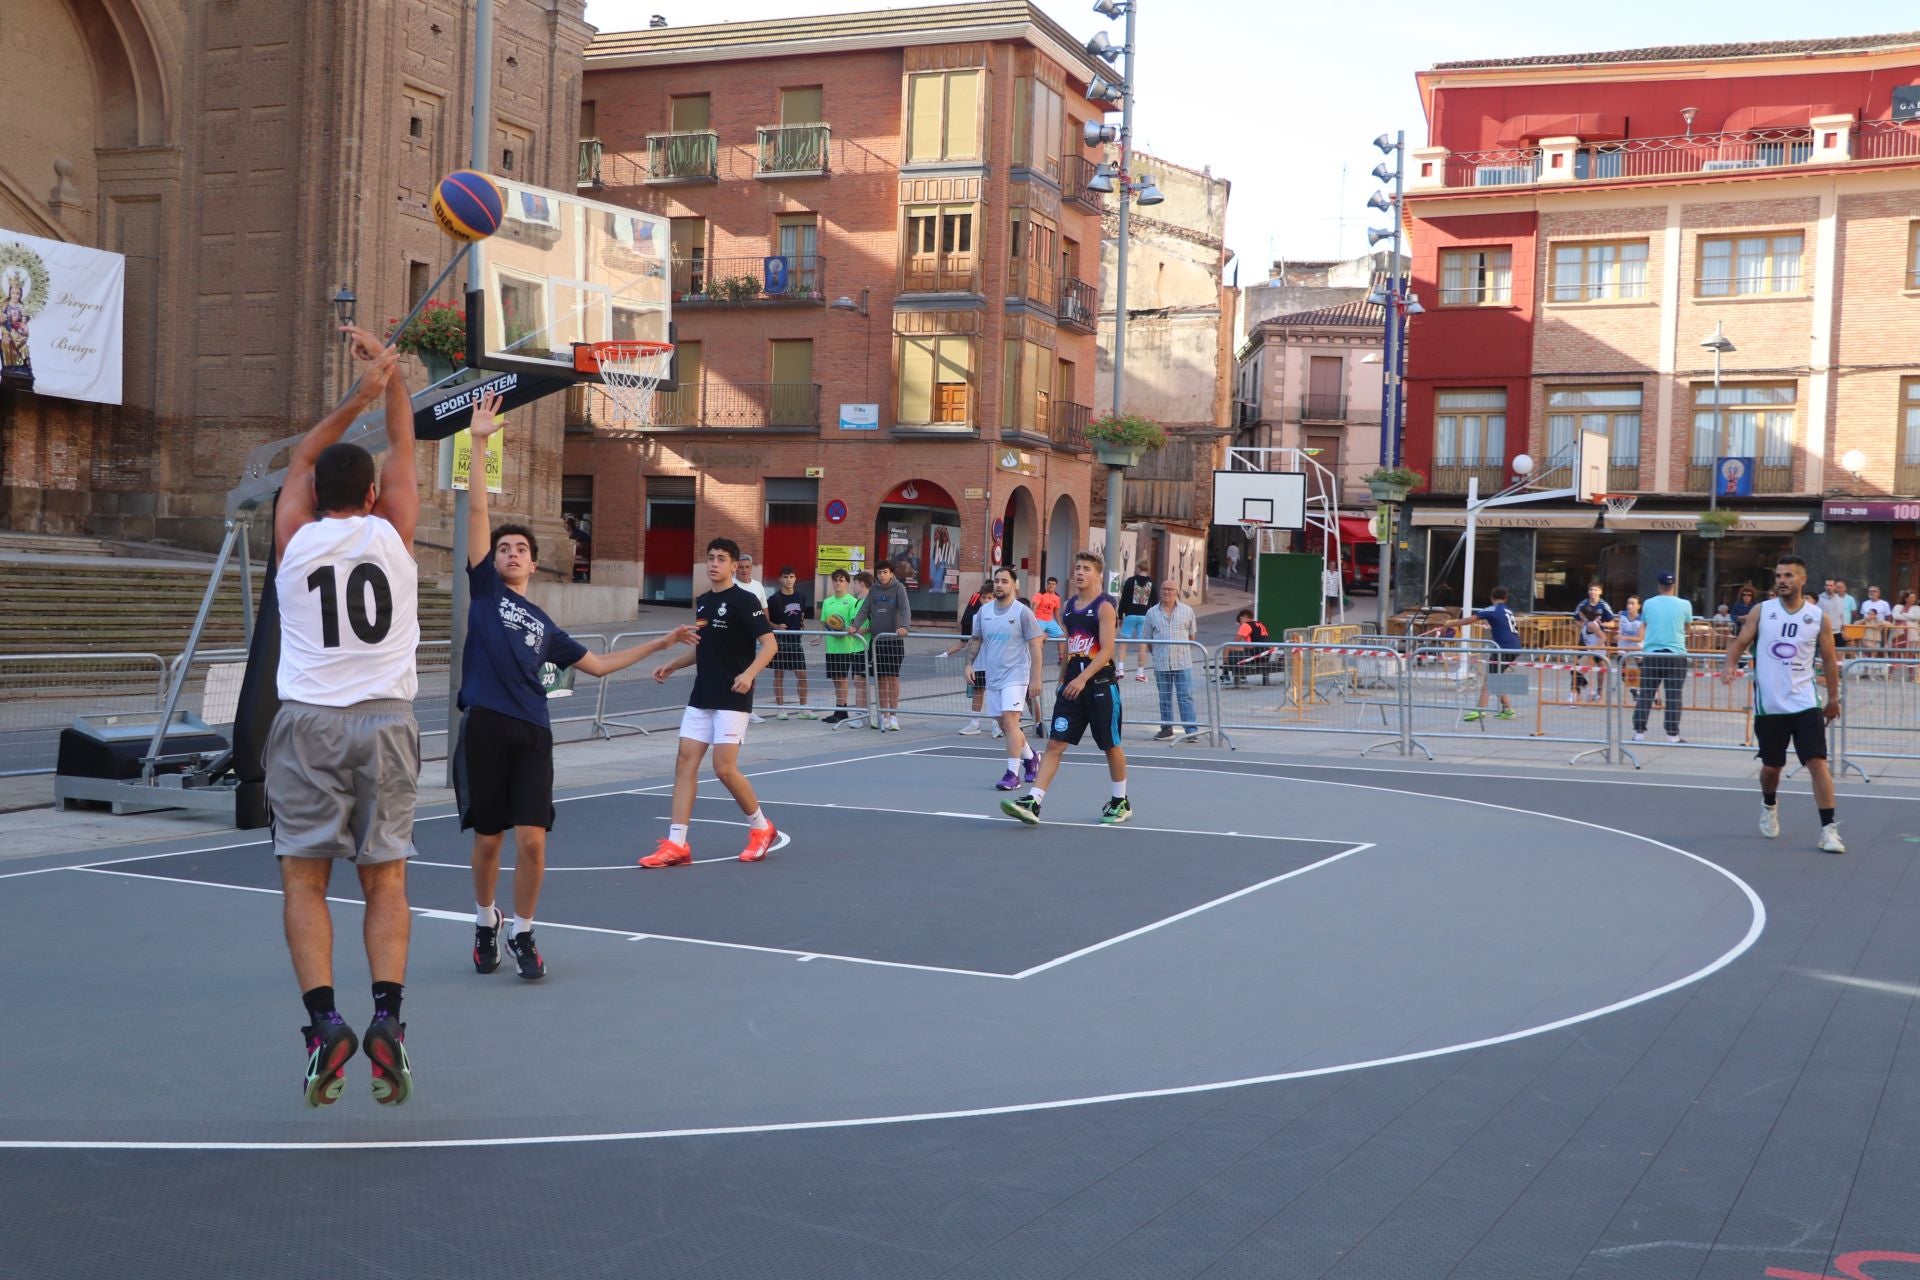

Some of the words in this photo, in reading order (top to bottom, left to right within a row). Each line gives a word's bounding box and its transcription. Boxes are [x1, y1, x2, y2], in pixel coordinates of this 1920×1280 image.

[435, 201, 470, 239] Wilson
[55, 290, 105, 319] Virgen
[68, 323, 84, 333] del
[50, 336, 97, 363] Burgo
[433, 391, 470, 416] SPORT
[472, 373, 518, 400] SYSTEM
[1454, 518, 1493, 526] CANO
[1500, 518, 1513, 527] LA
[1651, 520, 1693, 529] CASINO
[1893, 504, 1920, 519] 100
[935, 539, 957, 565] WIN
[307, 562, 393, 648] 10
[1781, 622, 1798, 638] 10
